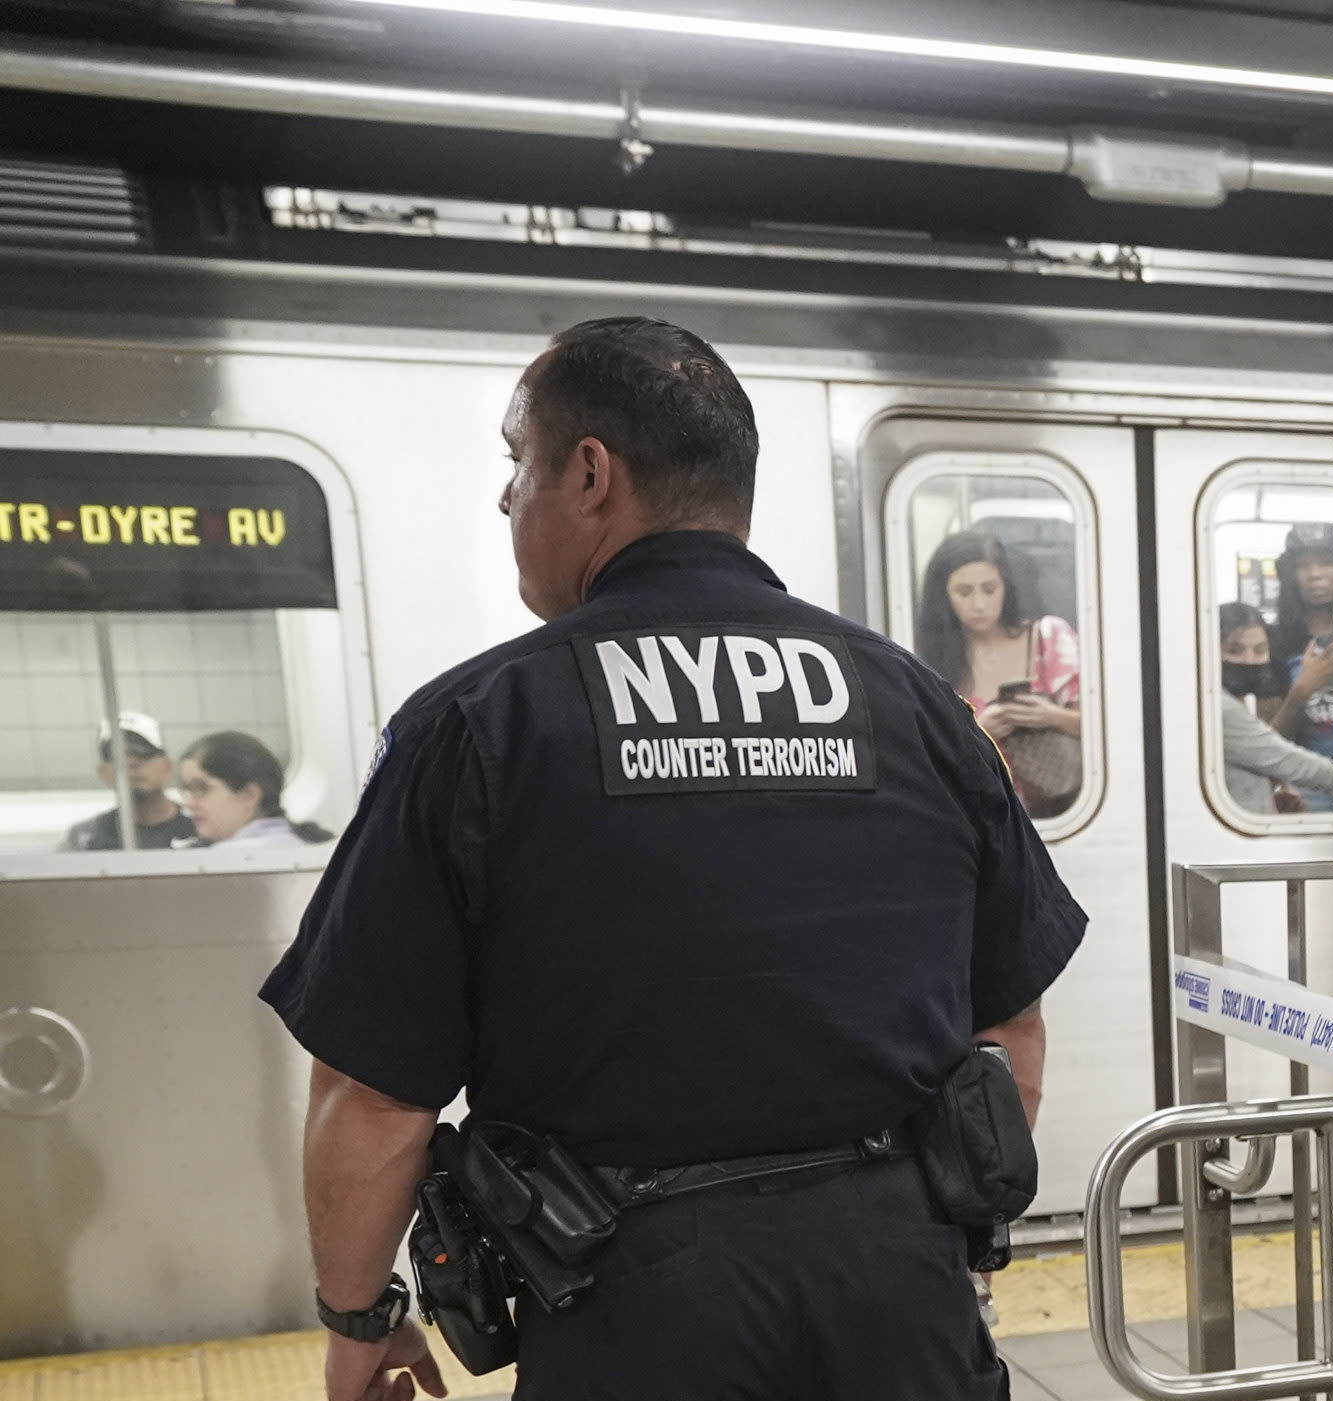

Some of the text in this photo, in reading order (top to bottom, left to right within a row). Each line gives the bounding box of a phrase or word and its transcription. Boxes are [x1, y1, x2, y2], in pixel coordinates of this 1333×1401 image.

[228, 508, 286, 547] AV
[595, 636, 850, 725] NYPD
[621, 737, 857, 780] COUNTER TERRORISM
[1221, 988, 1241, 1019] CROSS
[1240, 993, 1255, 1024] NOT
[1253, 998, 1264, 1028] DO
[1268, 1003, 1287, 1033] LINE
[1285, 1006, 1311, 1041] POLICE
